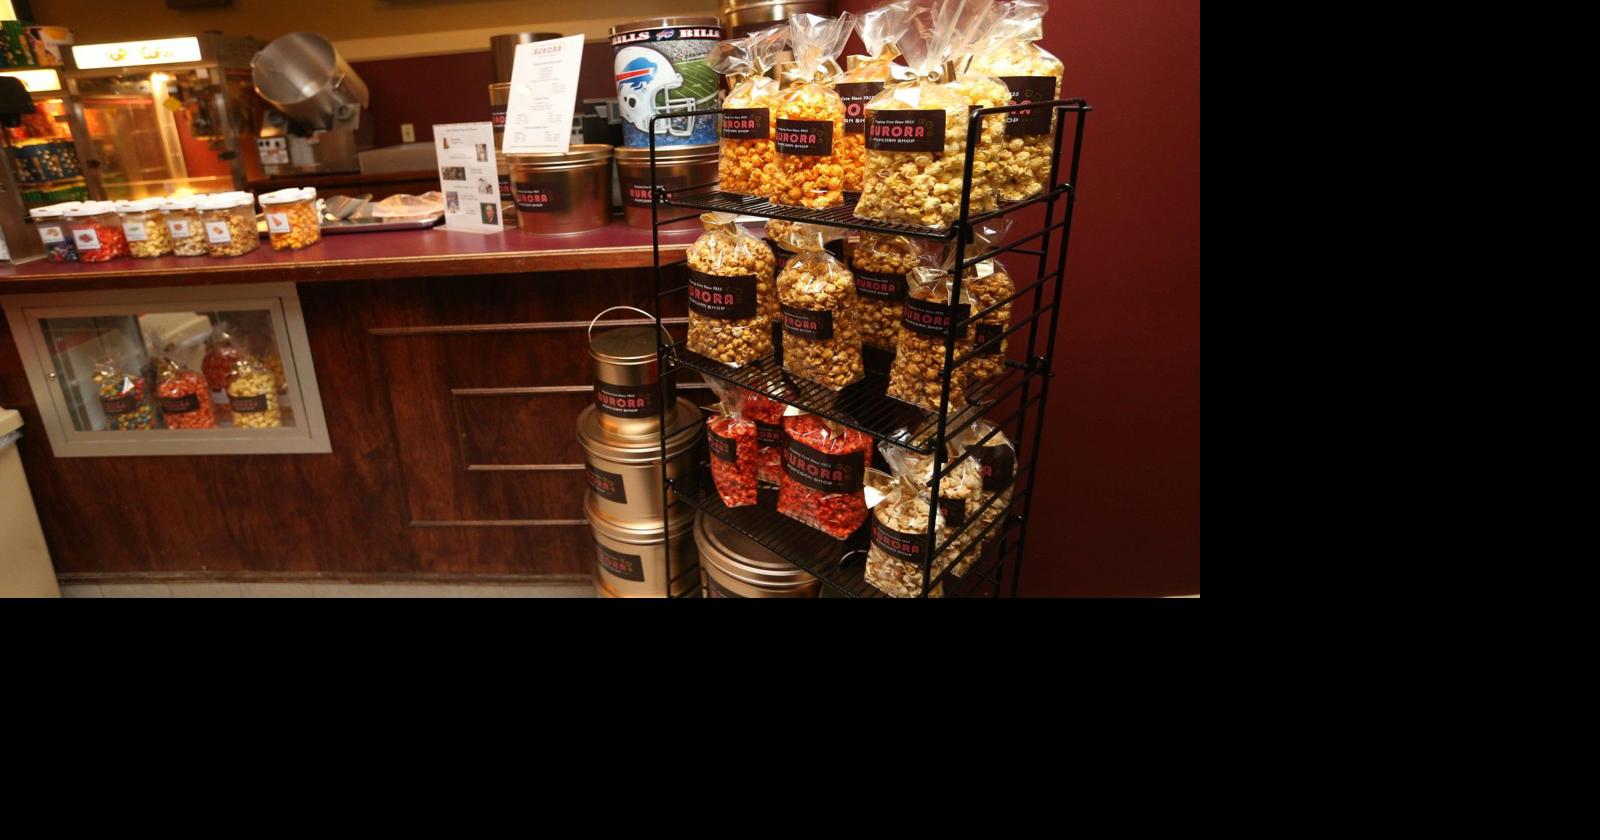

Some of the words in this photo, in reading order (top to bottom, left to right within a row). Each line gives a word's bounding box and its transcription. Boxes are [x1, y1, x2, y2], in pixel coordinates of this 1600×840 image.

[679, 29, 720, 38] BILLS
[723, 120, 755, 129] RORA
[870, 125, 925, 137] AURORA
[517, 193, 548, 203] RORA
[688, 284, 734, 305] URORA
[598, 392, 645, 408] AURORA
[783, 448, 842, 480] AURORA
